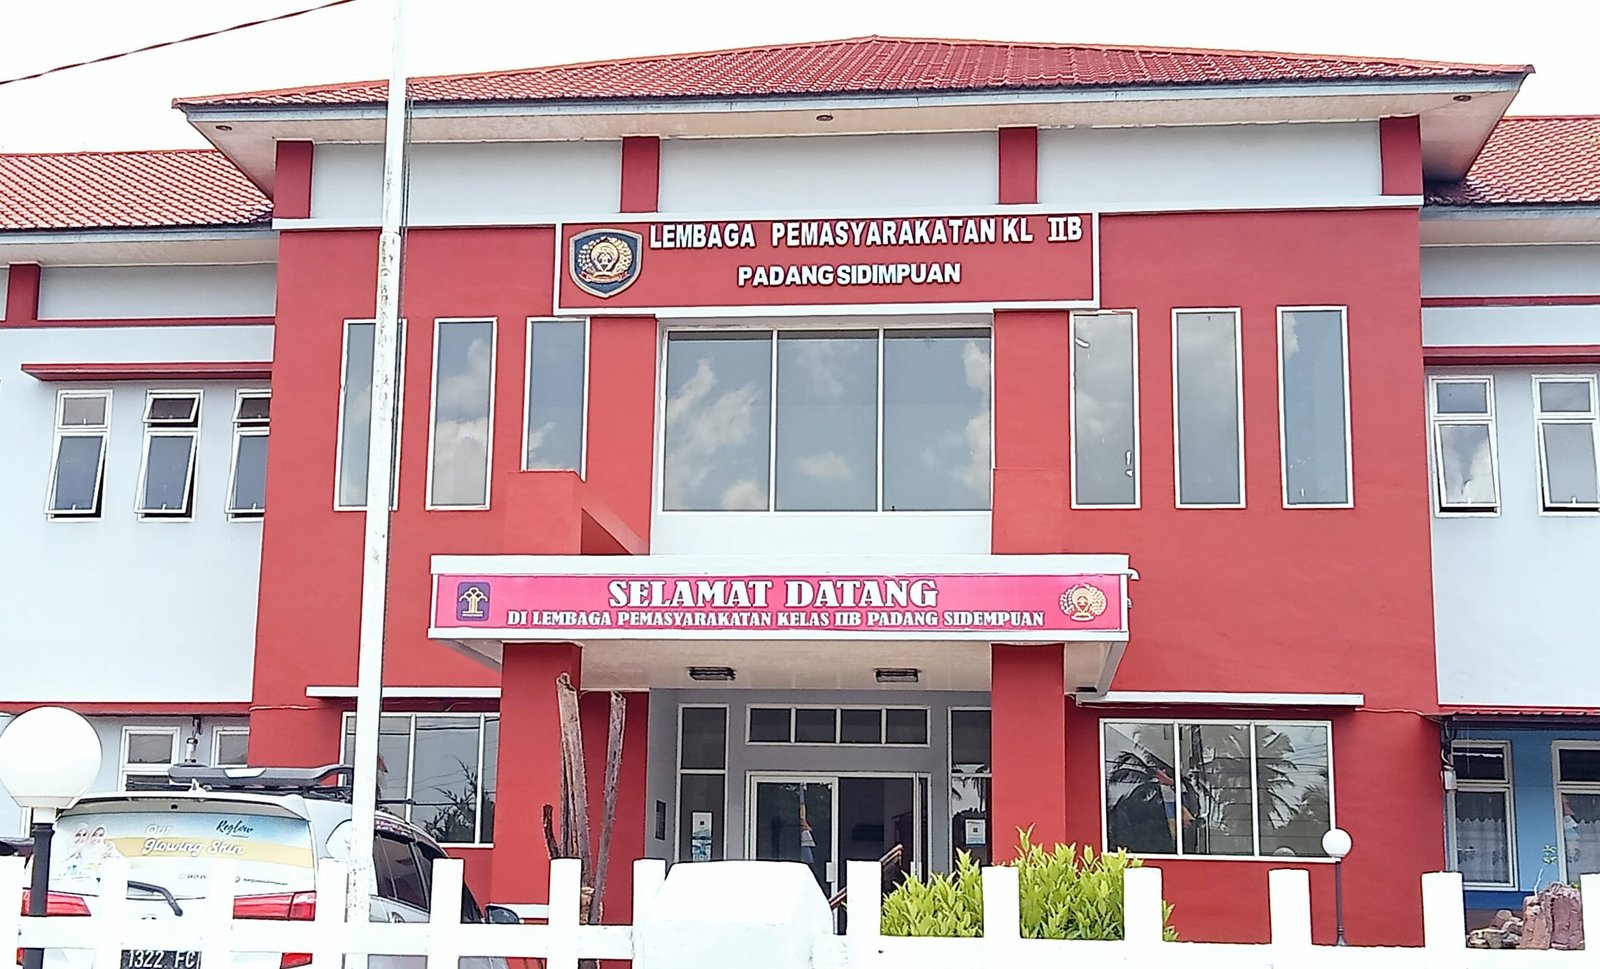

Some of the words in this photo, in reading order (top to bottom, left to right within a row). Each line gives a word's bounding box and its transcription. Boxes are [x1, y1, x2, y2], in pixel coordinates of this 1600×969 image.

[649, 223, 756, 249] LEMBAGA
[771, 217, 996, 248] PEMASYARAKATAN
[1001, 216, 1034, 244] KL
[1047, 214, 1083, 242] IIB
[608, 579, 773, 608] SELAMAT
[785, 579, 938, 608] DATANG
[507, 610, 528, 626] DI
[533, 610, 612, 627] LEMBAGA
[617, 610, 772, 627] PEMASYARAKATAN
[777, 611, 830, 627] KELAS
[835, 611, 862, 627] IIB
[867, 611, 939, 627] PADANG
[943, 611, 1045, 627] SIDEMPUAN
[128, 950, 165, 968] 1322
